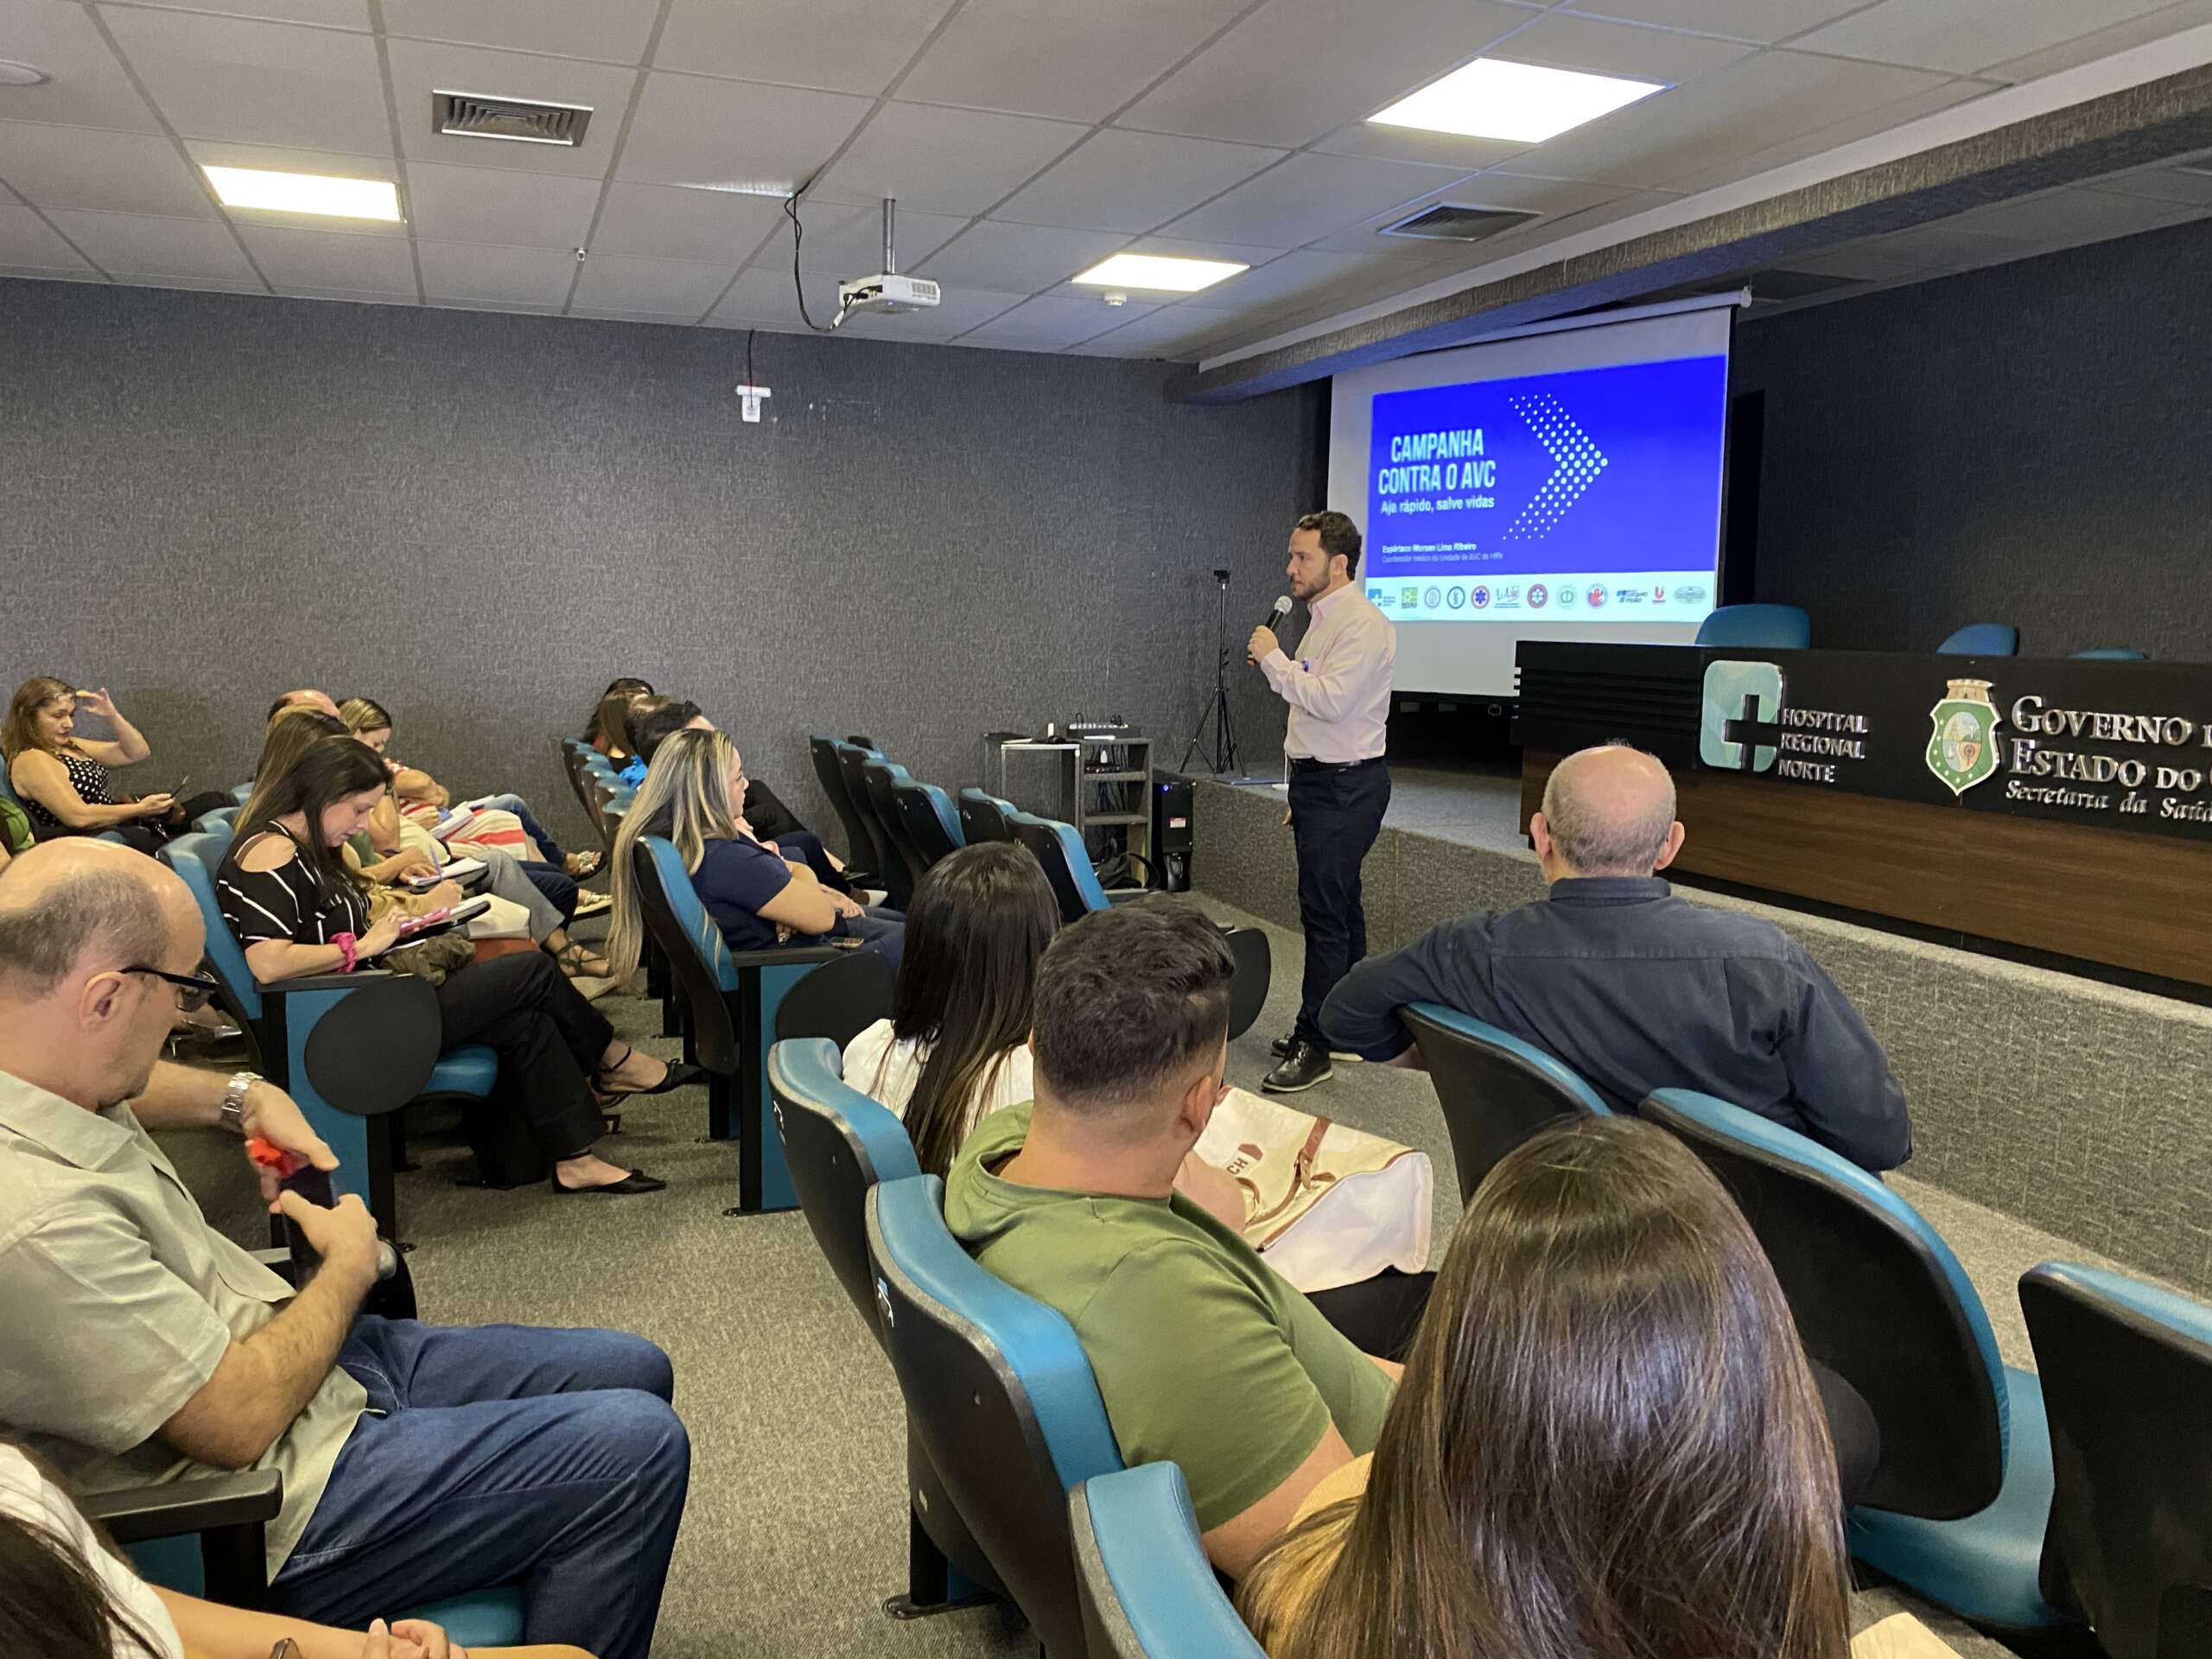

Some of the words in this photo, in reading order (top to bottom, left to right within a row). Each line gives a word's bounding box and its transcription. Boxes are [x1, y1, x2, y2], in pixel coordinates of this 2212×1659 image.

[1391, 429, 1484, 462] CAMPANHA
[1378, 464, 1441, 494] CONTRA
[1446, 463, 1458, 490] O
[1461, 460, 1496, 489] AVC
[1381, 500, 1396, 516] Aja
[1400, 498, 1433, 515] rápido,
[1436, 496, 1463, 510] salve
[1465, 494, 1495, 508] vidas
[1783, 709, 1868, 733] HOSPITAL
[2012, 695, 2192, 746] GOVERNO
[1781, 733, 1866, 759] REGIONAL
[1778, 760, 1835, 783] NORTE
[2009, 738, 2147, 787] ESTADO
[2155, 766, 2202, 791] DO
[2005, 780, 2109, 809] Secretaria
[2120, 791, 2147, 814] da
